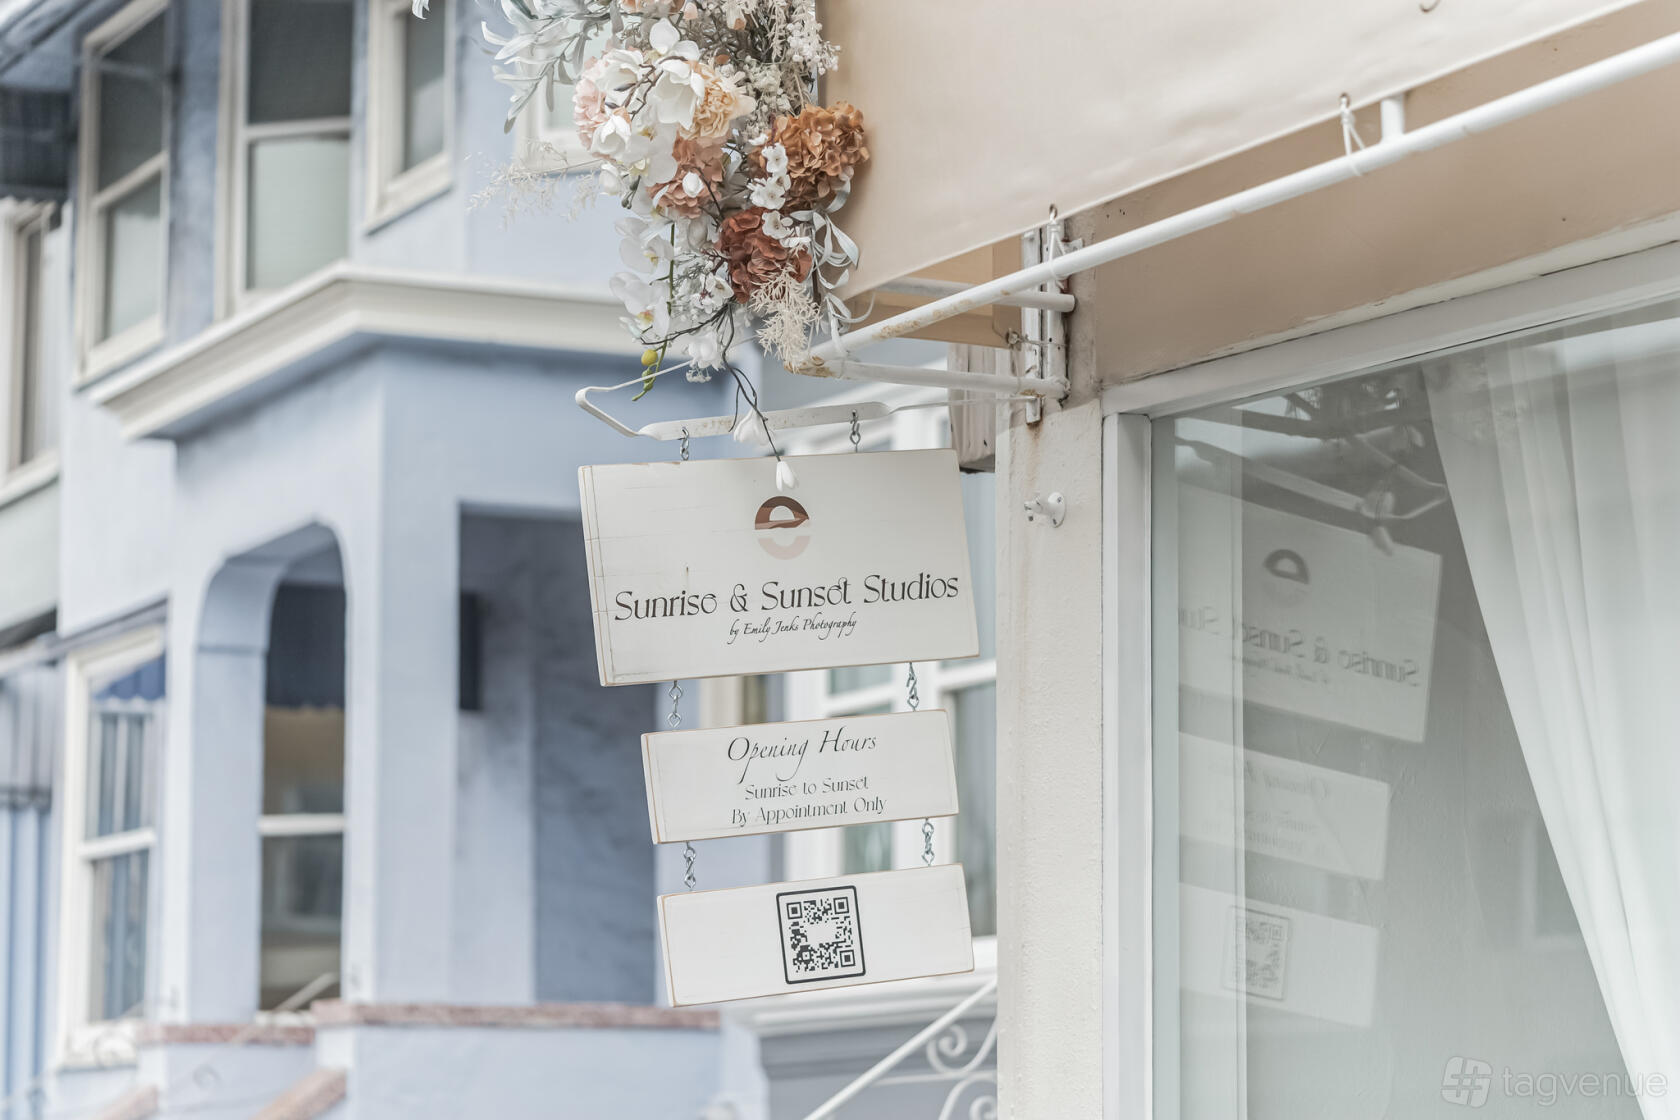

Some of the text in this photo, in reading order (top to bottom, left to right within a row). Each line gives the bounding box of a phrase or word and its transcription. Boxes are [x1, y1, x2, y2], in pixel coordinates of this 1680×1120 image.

[614, 572, 959, 621] Sunrise & Sunset Studios
[727, 611, 857, 645] by Emily Jenks Photography
[727, 725, 877, 785] Opening Hours
[745, 775, 869, 801] Sunrise to Sunset
[732, 796, 888, 828] By Appointment Only
